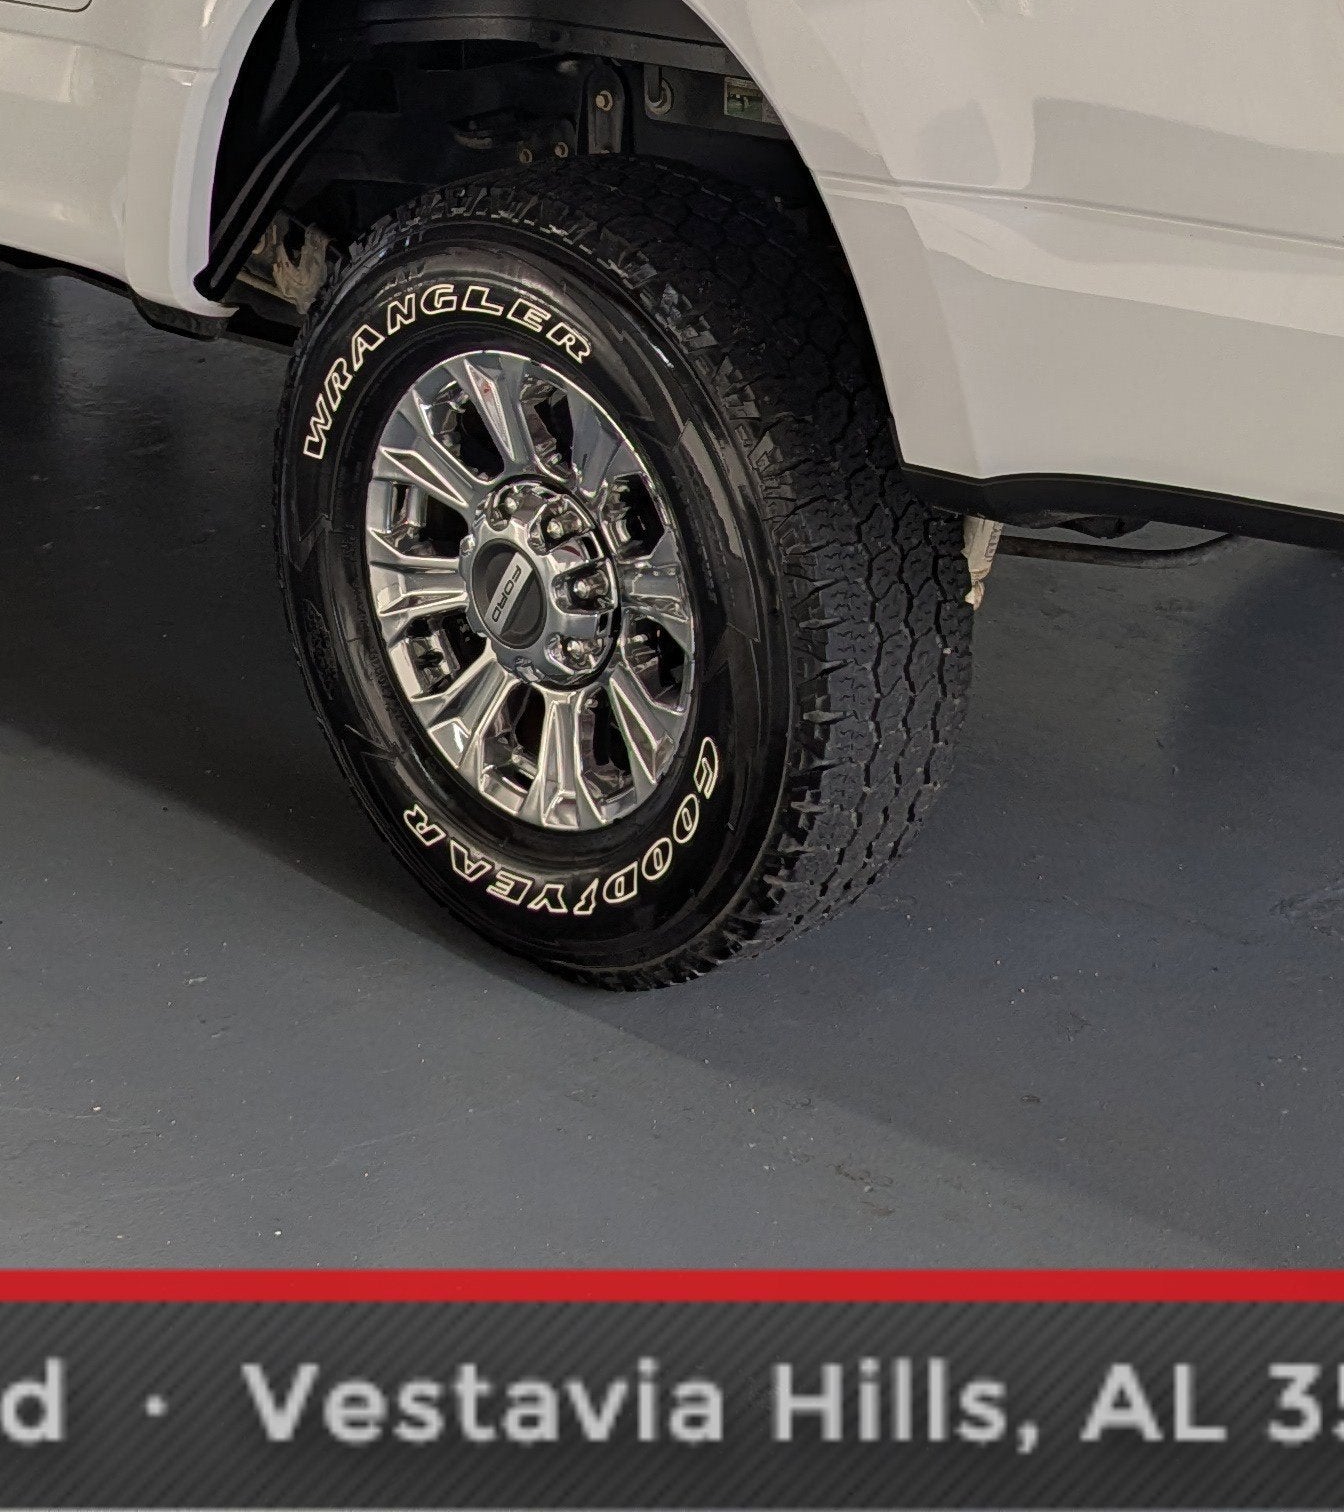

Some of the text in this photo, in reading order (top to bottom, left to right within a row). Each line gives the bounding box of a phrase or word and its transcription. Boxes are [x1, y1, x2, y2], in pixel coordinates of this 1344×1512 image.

[303, 283, 592, 461] WRANGLER
[491, 564, 523, 625] FORD
[403, 735, 720, 915] GOODYEAR
